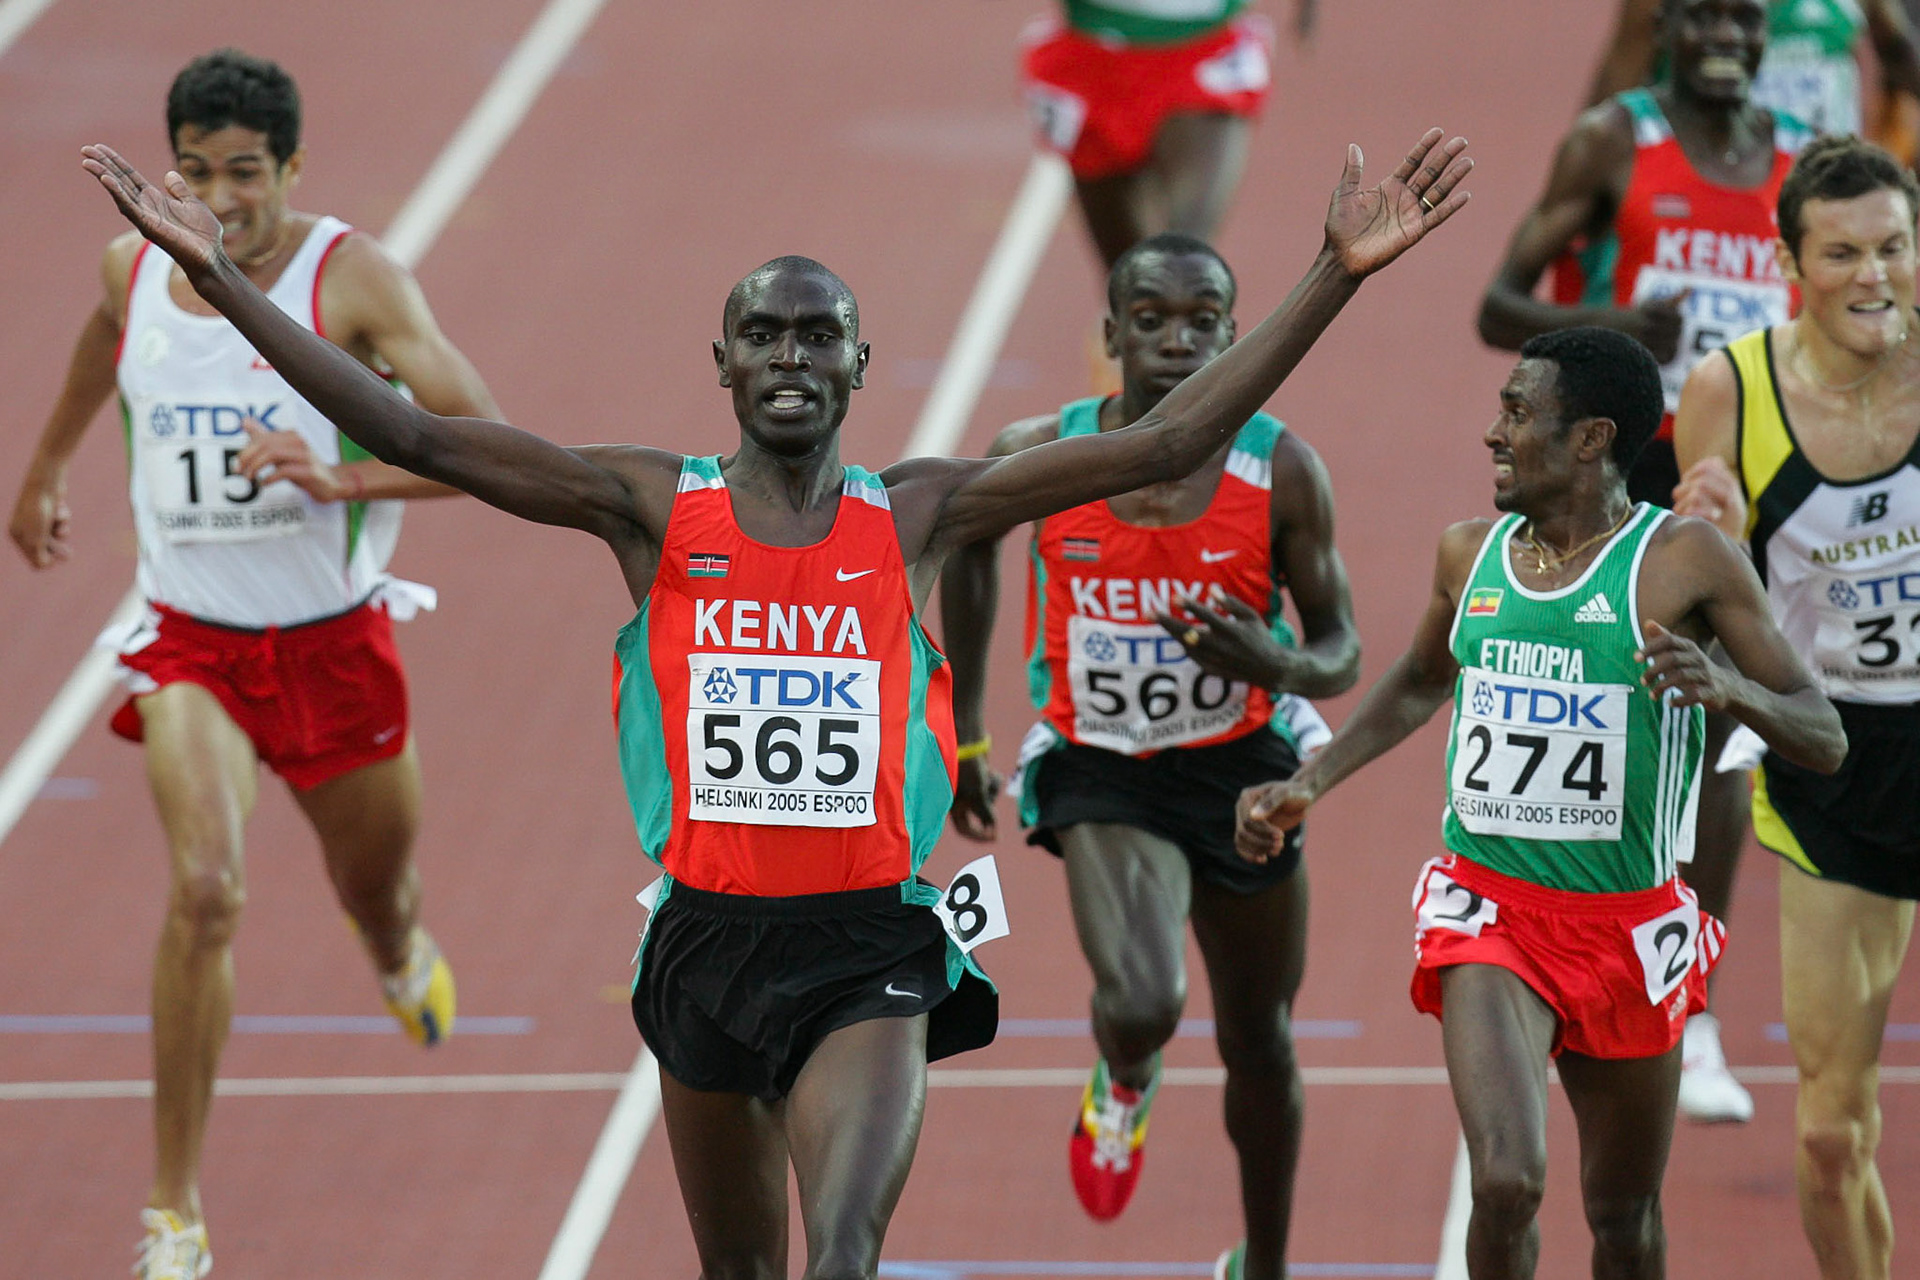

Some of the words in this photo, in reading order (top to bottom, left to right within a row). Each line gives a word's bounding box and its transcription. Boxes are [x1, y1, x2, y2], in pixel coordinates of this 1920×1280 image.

[175, 403, 282, 437] TDK
[694, 598, 868, 656] KENYA
[1574, 611, 1618, 624] adidas
[1854, 612, 1920, 668] 3
[1115, 635, 1189, 665] TD
[1479, 638, 1585, 684] ETHIOPIA
[735, 668, 864, 710] TDK
[1086, 668, 1233, 721] 560
[1494, 684, 1609, 730] TDK
[703, 713, 861, 787] 565
[1464, 724, 1608, 802] 274
[695, 787, 763, 811] HELSINKI
[767, 792, 808, 812] 2005
[813, 794, 868, 815] ESPOO
[1515, 804, 1554, 824] 2005
[1559, 807, 1618, 826] ESPOO
[944, 872, 989, 944] 8
[1653, 920, 1689, 986] 2
